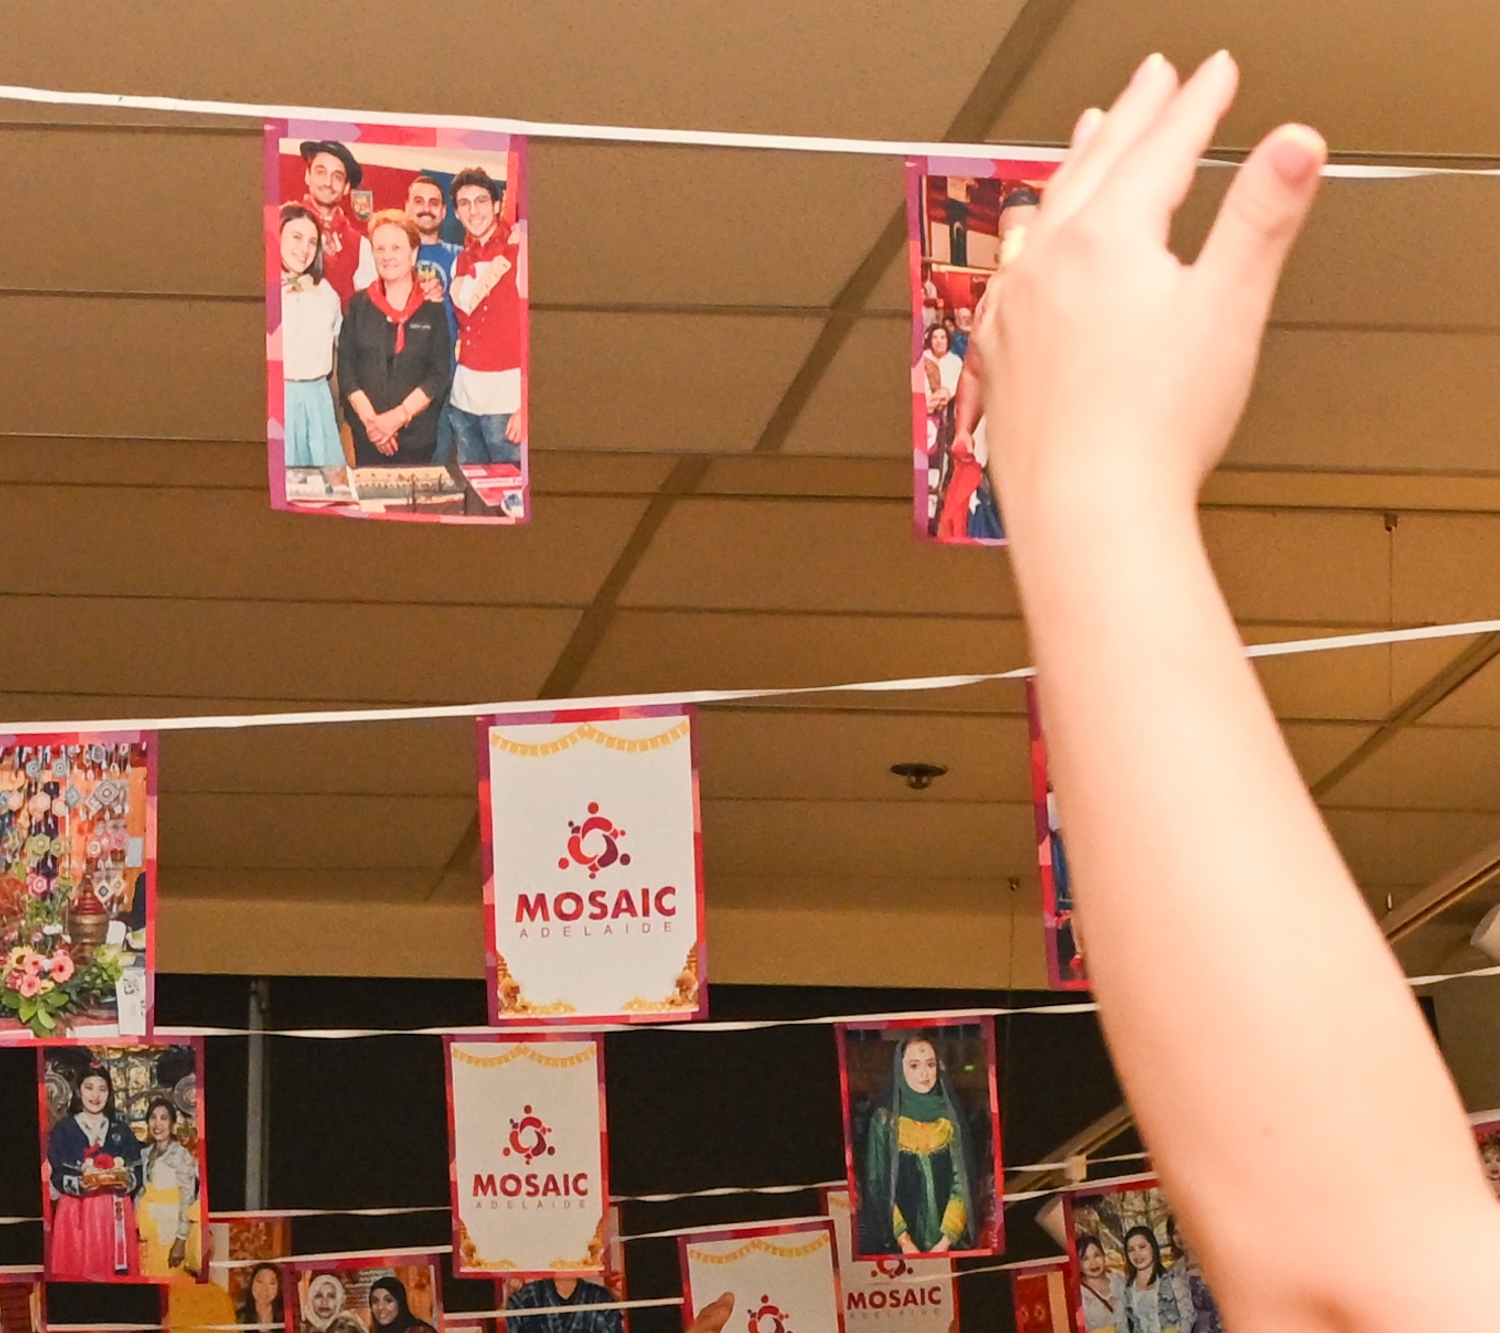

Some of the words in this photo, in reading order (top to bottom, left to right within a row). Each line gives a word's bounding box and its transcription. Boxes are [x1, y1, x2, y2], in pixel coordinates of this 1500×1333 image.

[515, 886, 676, 923] MOSAIC
[519, 921, 672, 939] ADELAIDE
[472, 1173, 589, 1197] MOSAIC
[475, 1200, 585, 1210] ADELAIDE
[846, 1286, 942, 1310] MOSAIC
